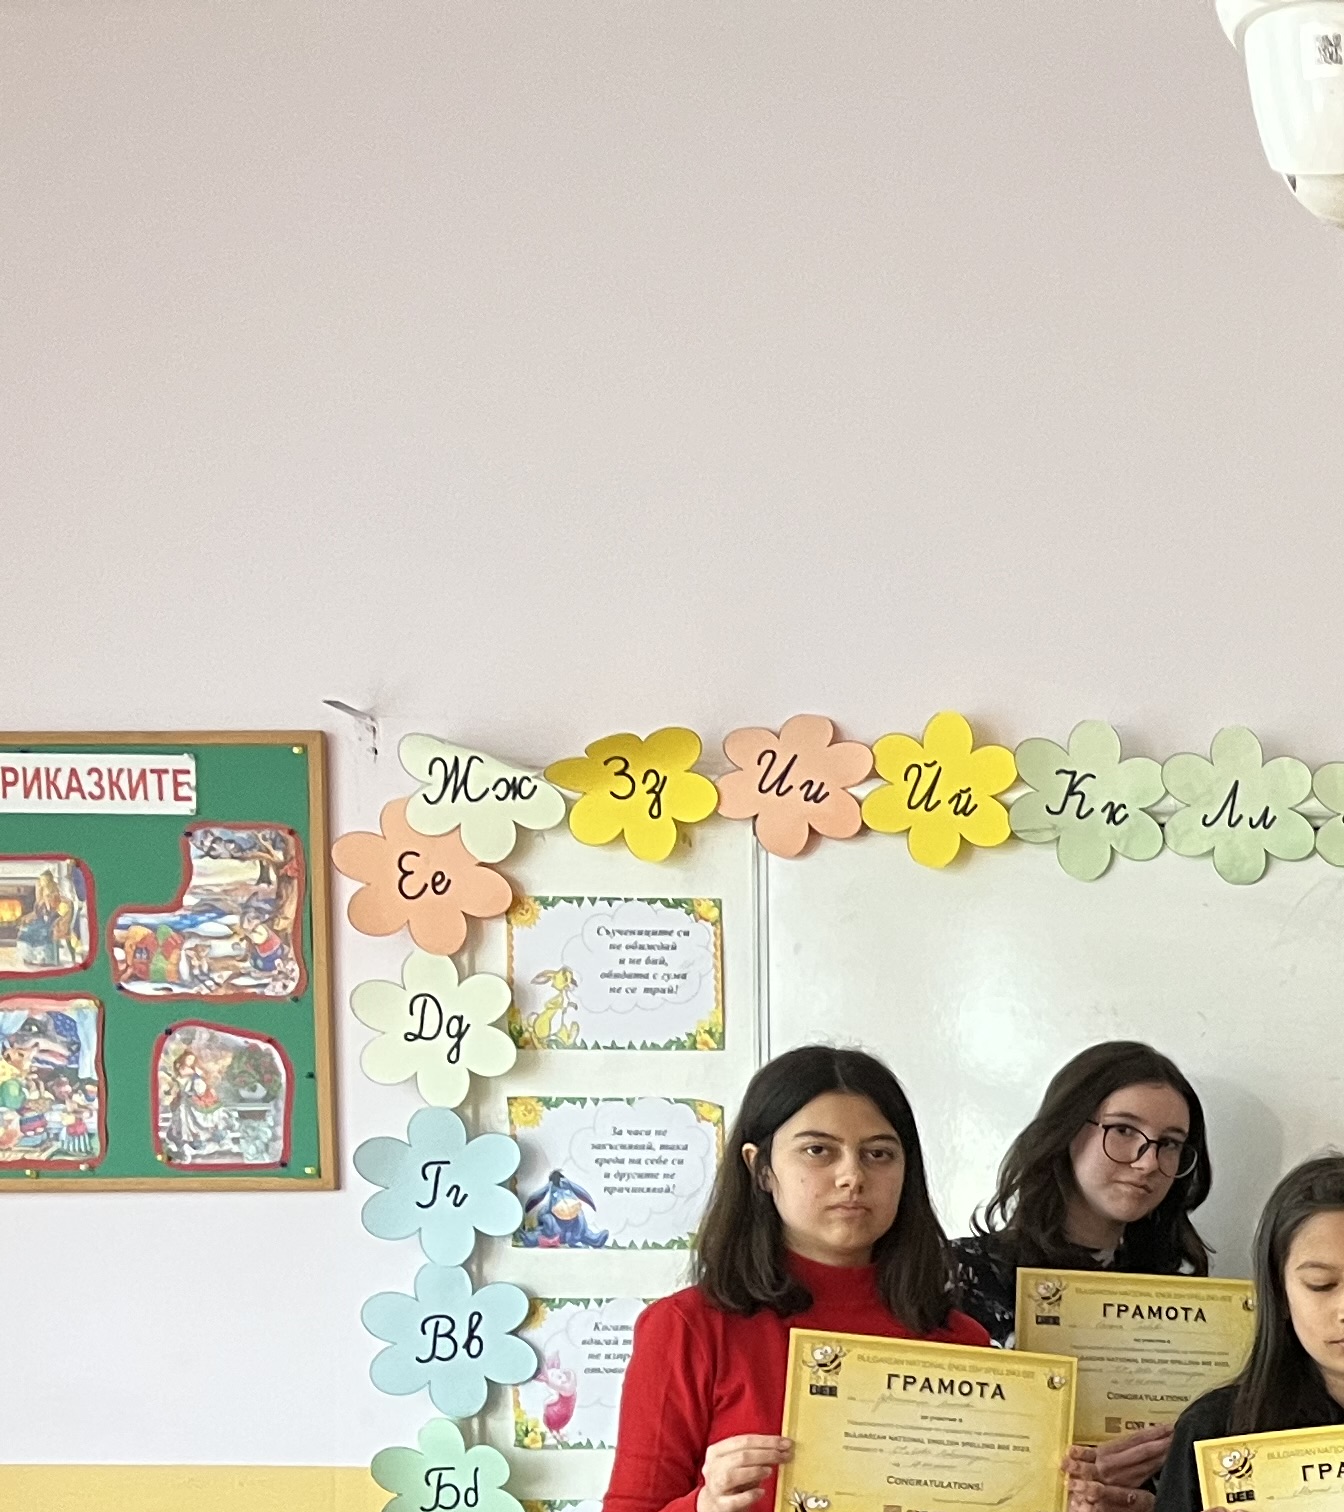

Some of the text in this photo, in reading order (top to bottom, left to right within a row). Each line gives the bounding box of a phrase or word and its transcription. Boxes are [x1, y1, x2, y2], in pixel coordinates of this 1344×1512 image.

[1, 767, 193, 802] РИКАЗКИТЕ
[1103, 1303, 1206, 1322] ГРАМОТА
[886, 1373, 1006, 1400] ГРАМОТА
[886, 1475, 984, 1492] CONGRATULATIONS!
